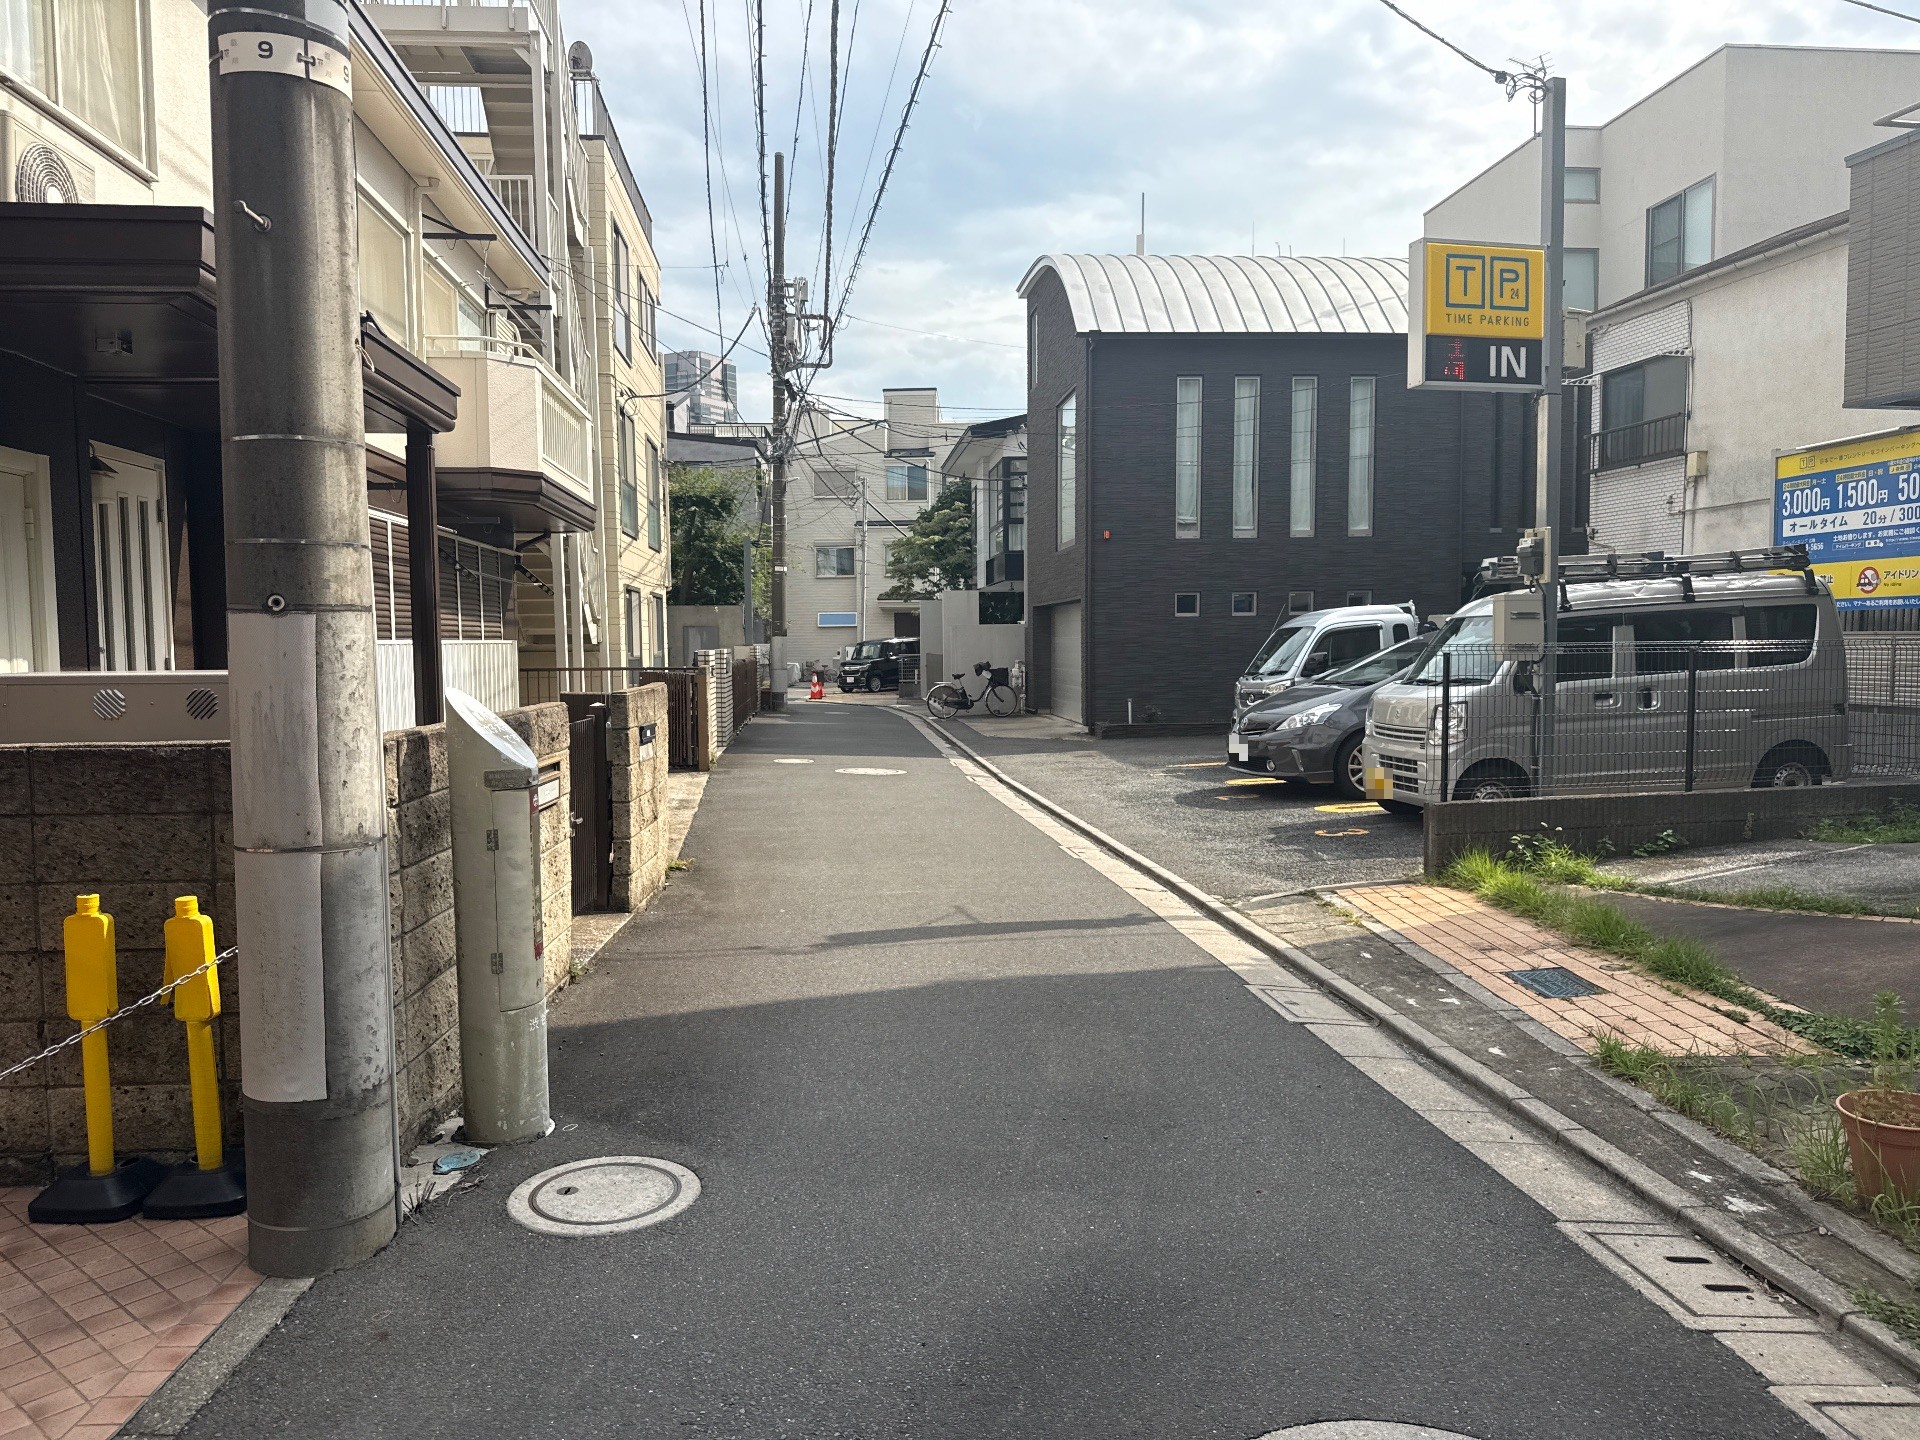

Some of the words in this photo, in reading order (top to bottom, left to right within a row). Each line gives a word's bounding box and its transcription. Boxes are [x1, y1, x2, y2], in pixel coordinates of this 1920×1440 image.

[258, 41, 273, 59] 9
[1510, 288, 1519, 299] 24
[1446, 313, 1473, 325] TIME
[1480, 314, 1530, 327] PARKING
[1489, 345, 1527, 379] IN
[1782, 487, 1830, 517] 3,000円
[1837, 479, 1888, 508] 1,500円
[1789, 515, 1848, 533] オールタイム
[1862, 510, 1887, 526] 20分
